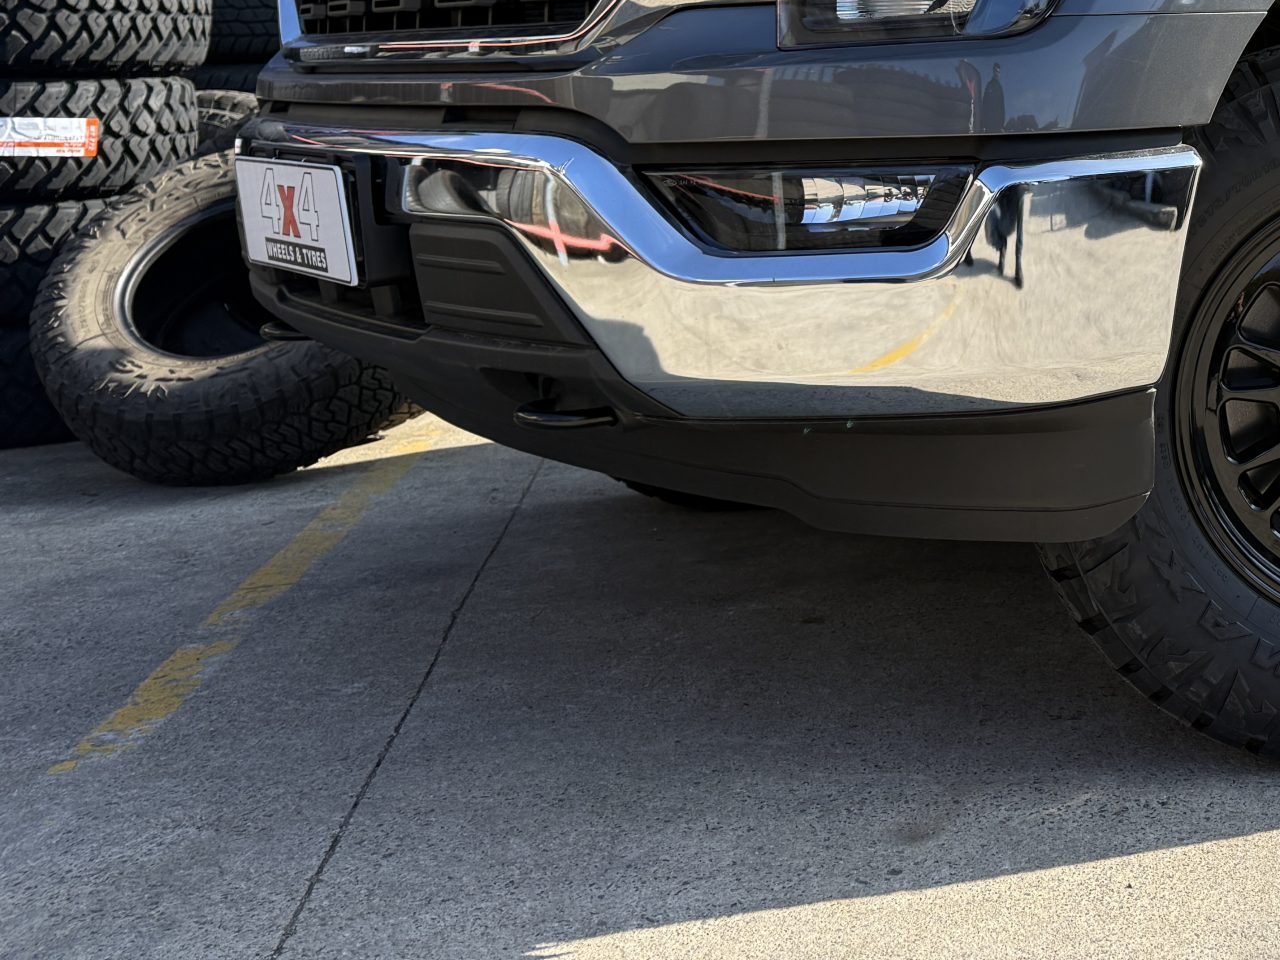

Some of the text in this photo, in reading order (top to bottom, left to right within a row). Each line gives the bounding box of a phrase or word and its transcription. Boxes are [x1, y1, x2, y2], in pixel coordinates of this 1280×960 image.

[267, 241, 327, 269] WHEELS & TYRES
